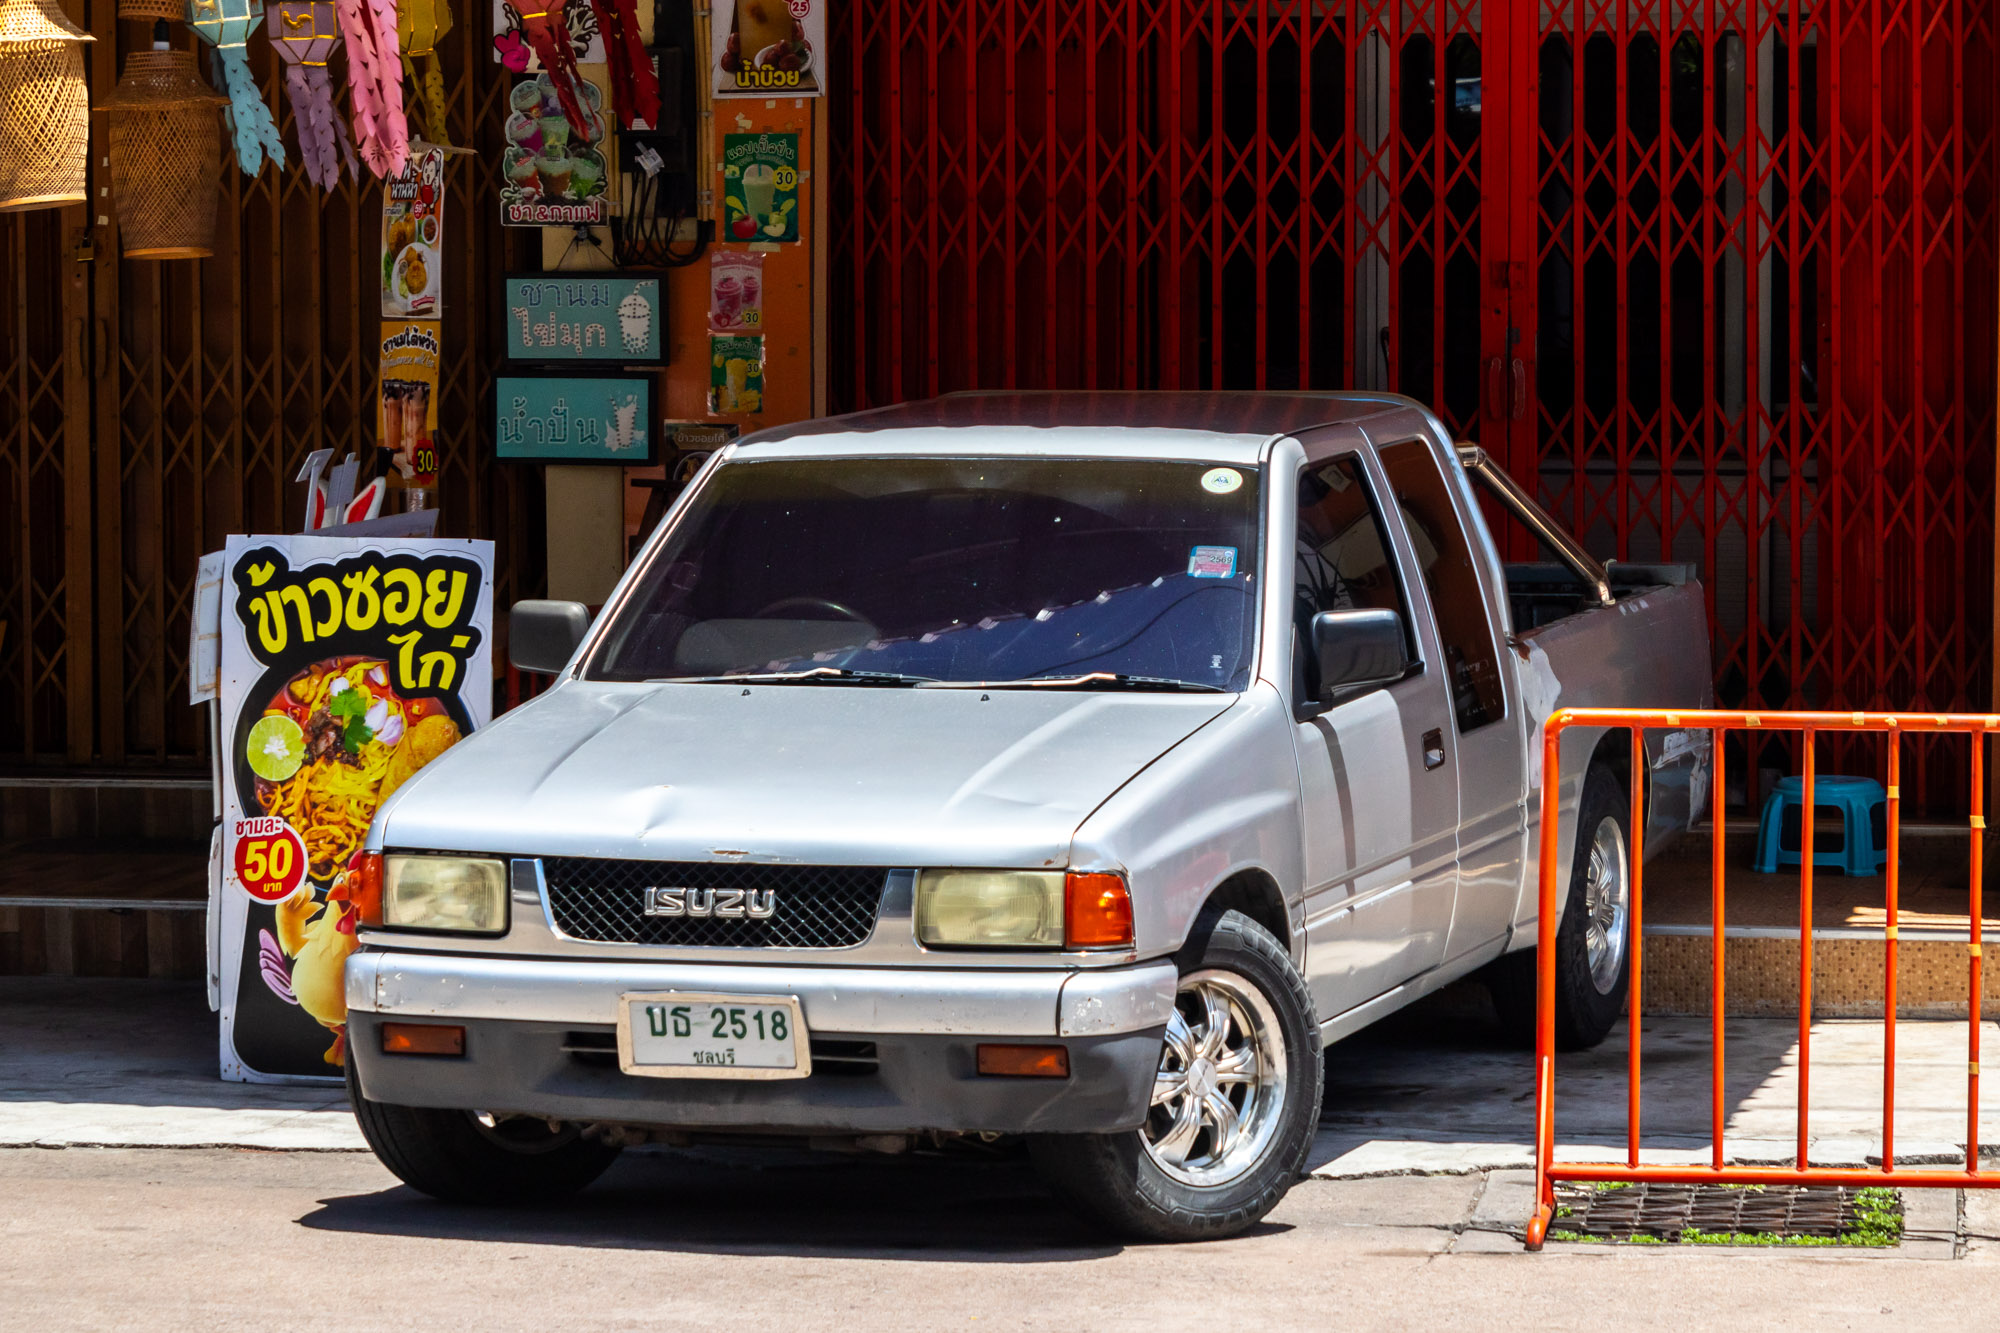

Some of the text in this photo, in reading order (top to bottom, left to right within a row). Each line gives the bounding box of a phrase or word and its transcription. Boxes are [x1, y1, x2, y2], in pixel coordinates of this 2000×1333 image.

[792, 1, 807, 12] 25
[736, 59, 800, 87] น้ำบ๊วย
[776, 171, 793, 185] 30
[520, 282, 610, 308] ชานม
[745, 313, 759, 323] 30
[512, 307, 606, 356] ไข่มุก
[747, 363, 760, 373] 30
[499, 396, 600, 444] น้ำปั่น
[677, 432, 726, 444] ข้าวซอยไก่
[1210, 555, 1233, 564] 2569
[246, 560, 468, 653] ข้าวซอย
[387, 630, 471, 691] ไก่
[235, 818, 281, 836] ชามละ
[243, 838, 293, 882] 50
[263, 881, 282, 893] บาท
[644, 886, 776, 918] ISUZU
[645, 1006, 788, 1041] บธ 2518
[693, 1047, 735, 1065] ชลบรี
